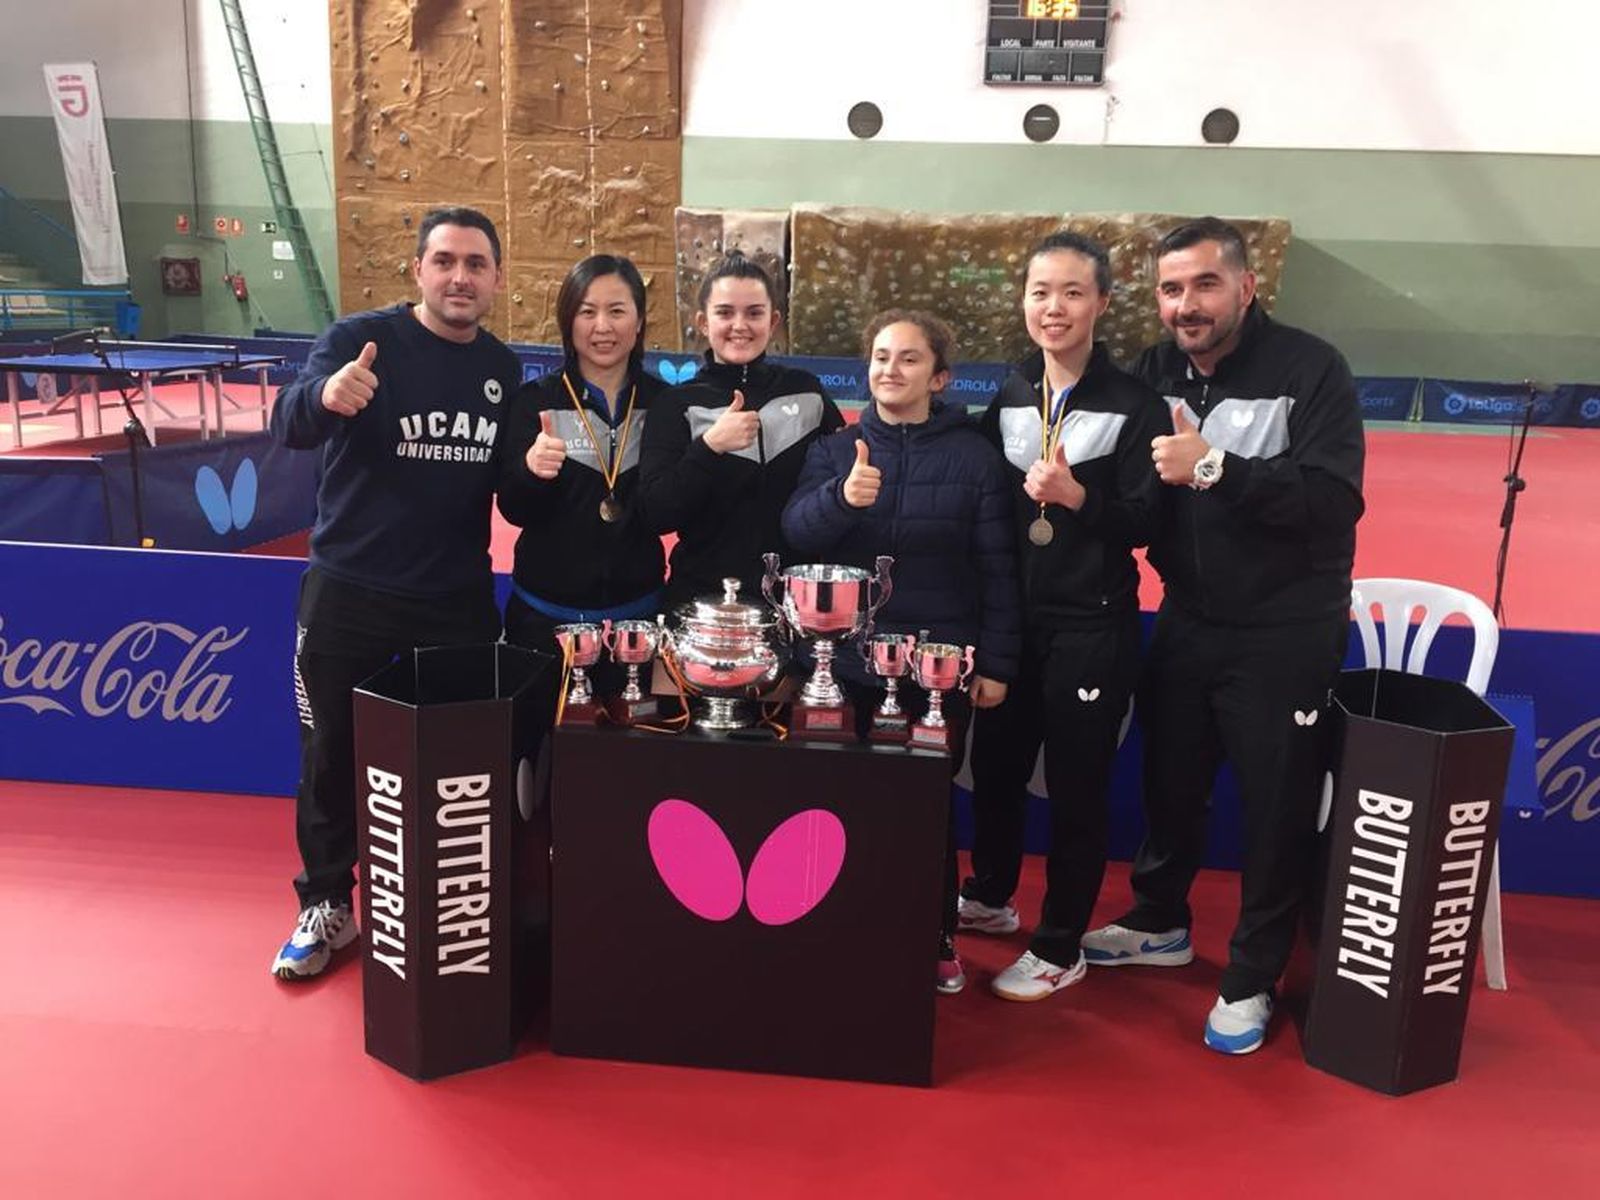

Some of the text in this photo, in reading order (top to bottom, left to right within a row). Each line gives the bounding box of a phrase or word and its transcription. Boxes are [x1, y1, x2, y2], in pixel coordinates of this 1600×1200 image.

[1000, 38, 1022, 48] LOCAL
[1035, 39, 1056, 49] PARTE
[1062, 39, 1097, 49] VISITANTE
[396, 441, 493, 463] UNIVERSIDAD
[400, 411, 498, 447] UCAM
[0, 614, 249, 723] ca-Cola
[366, 765, 406, 980] BUTTERFLY
[436, 774, 491, 976] BUTTERFLY
[1336, 788, 1414, 999] BUTTERFLY
[1422, 799, 1490, 995] BUTTERFLY
